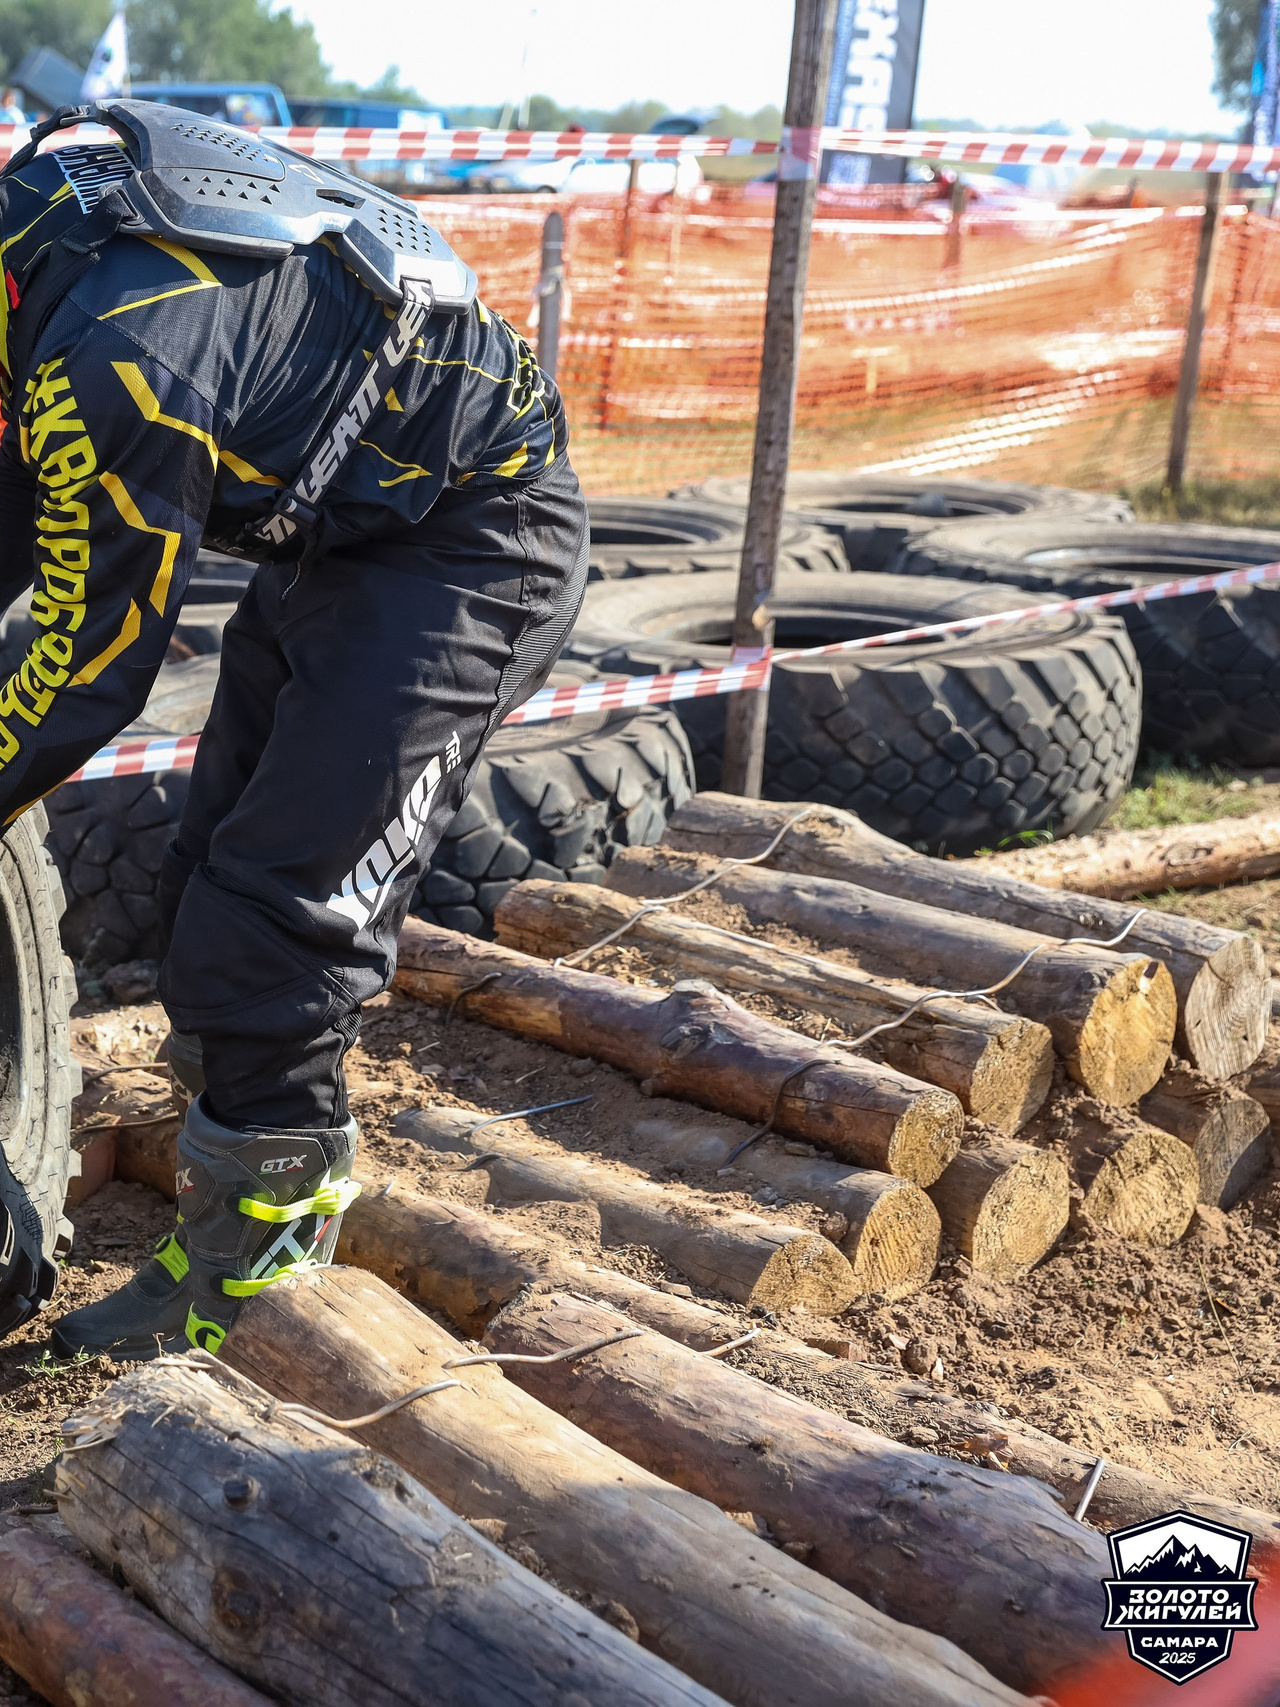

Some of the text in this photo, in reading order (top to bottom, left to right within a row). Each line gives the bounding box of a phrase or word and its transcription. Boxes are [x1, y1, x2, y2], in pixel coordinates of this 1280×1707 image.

[296, 361, 380, 504] LEATT
[326, 757, 443, 931] YOKO
[260, 1154, 308, 1173] GTX
